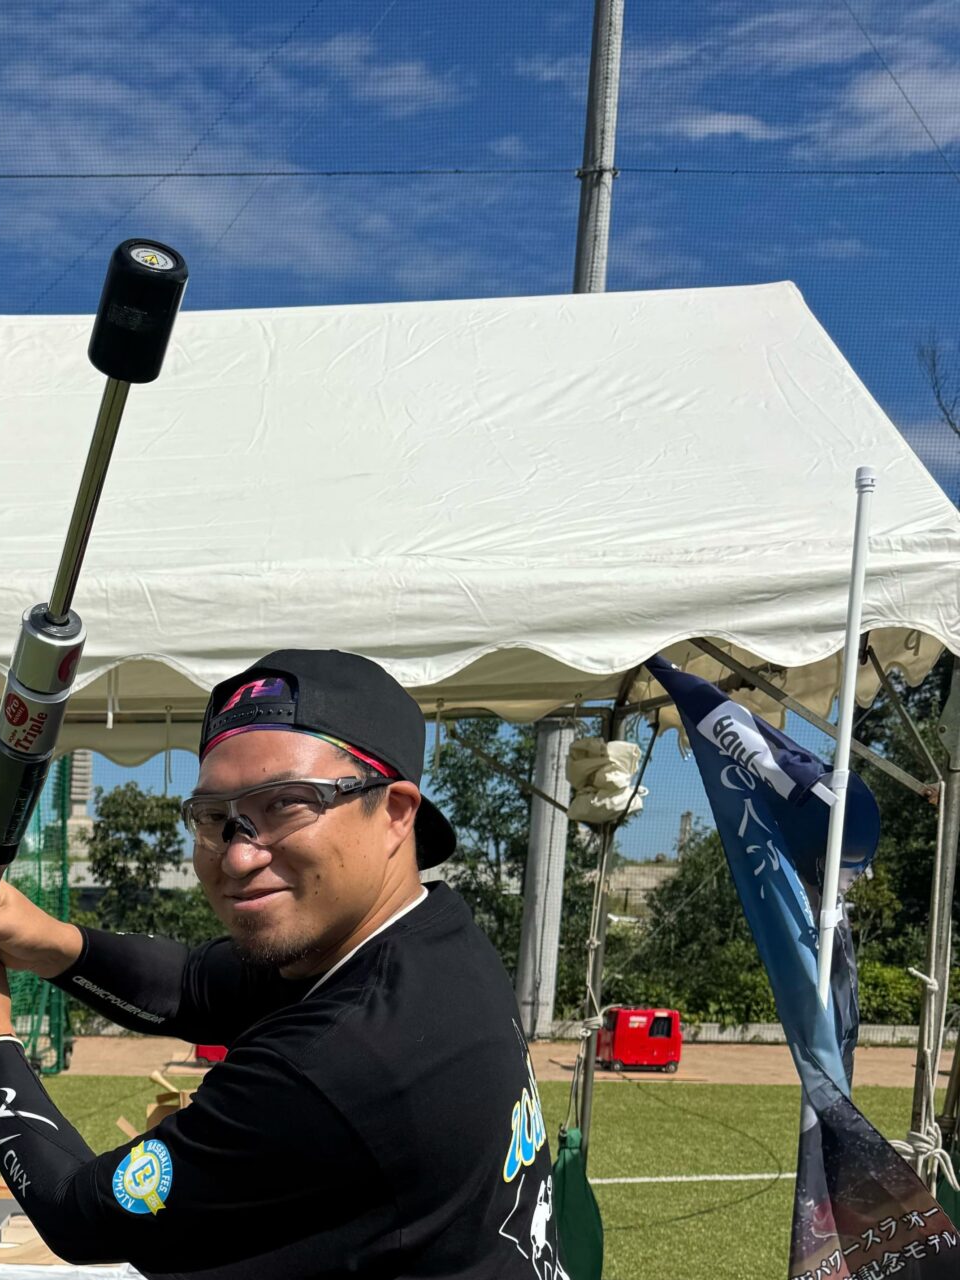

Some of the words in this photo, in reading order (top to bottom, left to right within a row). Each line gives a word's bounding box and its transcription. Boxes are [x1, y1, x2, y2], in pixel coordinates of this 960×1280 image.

[5, 699, 19, 719] Pro
[14, 713, 47, 751] Triple
[72, 975, 111, 999] CERAMIC
[105, 993, 142, 1015] POWER
[137, 1009, 166, 1024] GEAR
[3, 1149, 31, 1198] CW-X
[147, 1142, 172, 1174] BASEBALL
